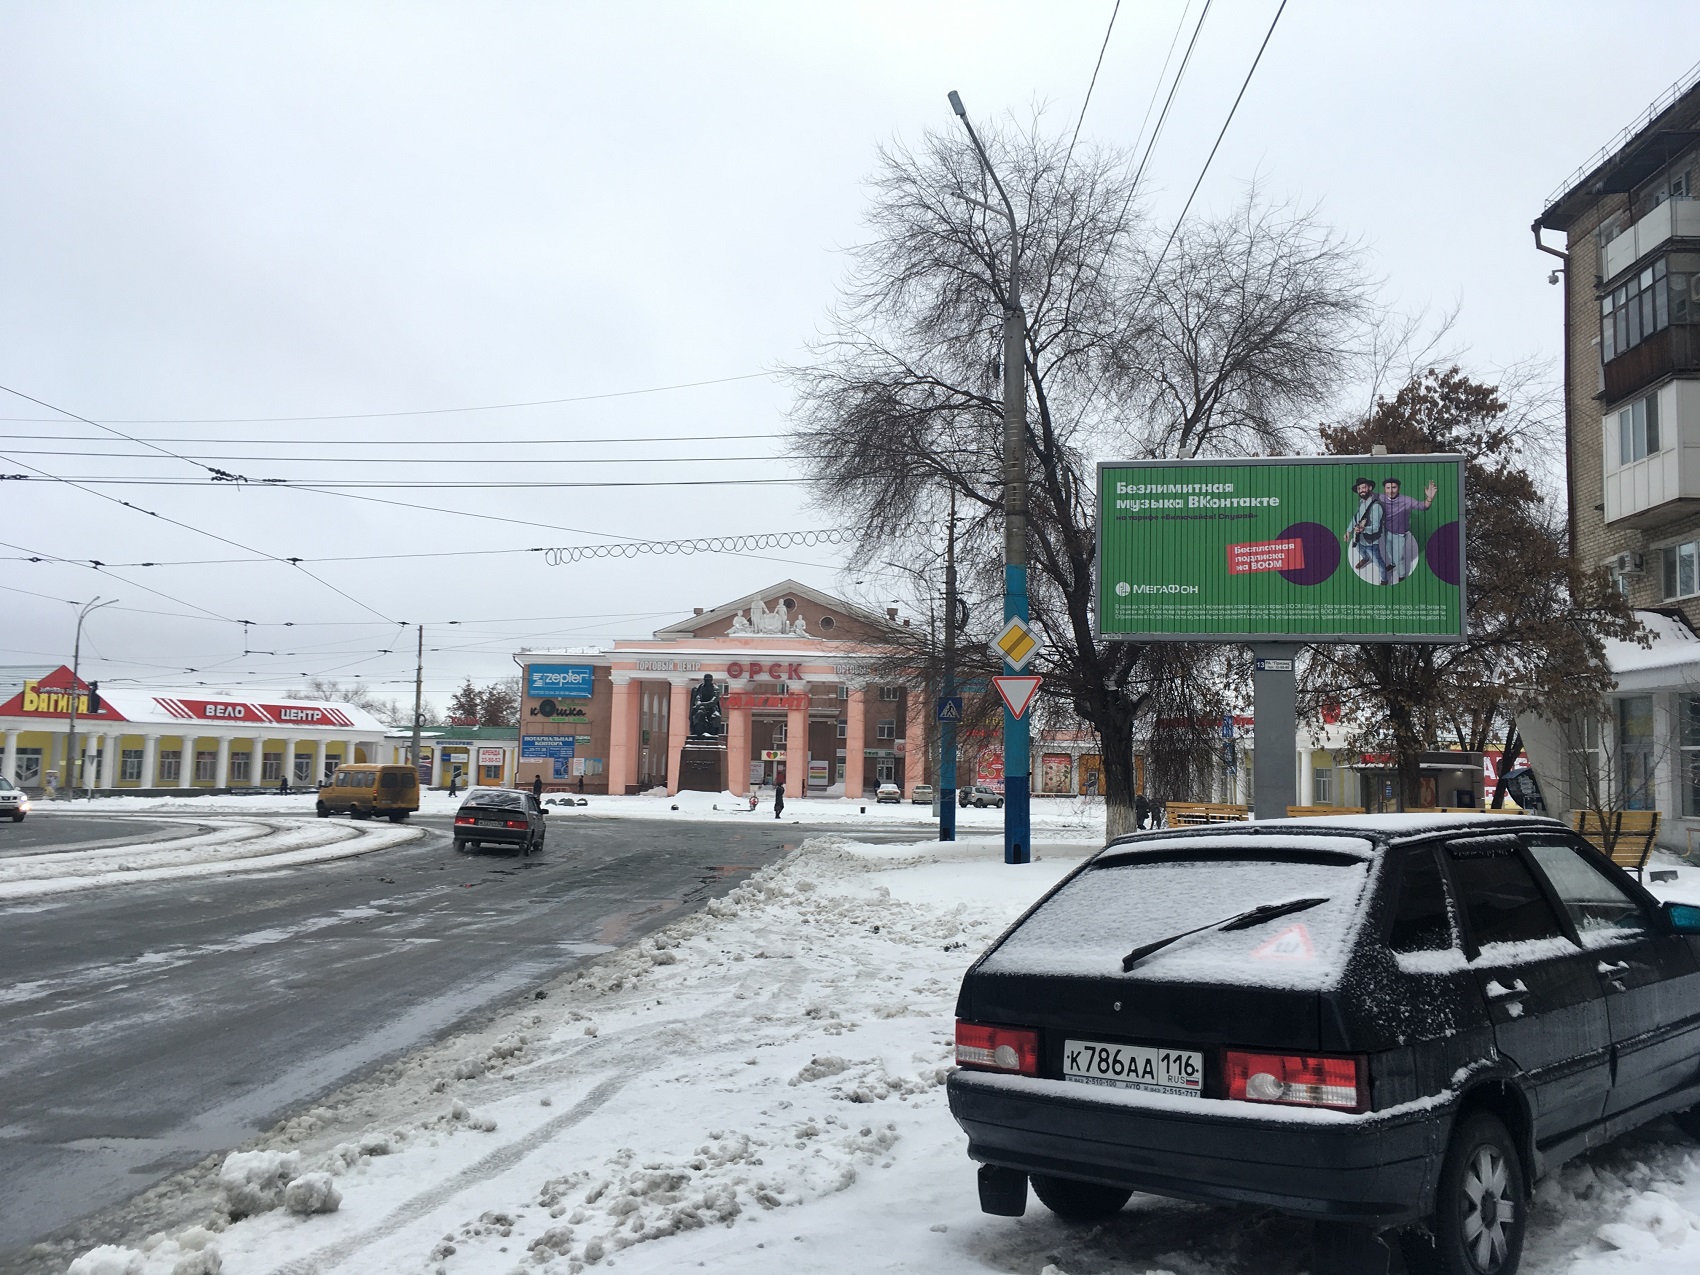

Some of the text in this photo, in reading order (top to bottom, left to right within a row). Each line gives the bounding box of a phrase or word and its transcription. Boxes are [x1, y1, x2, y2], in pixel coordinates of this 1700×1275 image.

[1116, 481, 1234, 494] Безлимитная
[1116, 495, 1280, 512] музыка ВКонтакте
[1234, 543, 1295, 554] Бесплатная
[1236, 552, 1285, 563] подписка
[637, 661, 700, 671] ТОРГОВЫЙ ЦЕНТР
[727, 662, 804, 680] ОРСК
[543, 669, 589, 687] zepter
[726, 696, 805, 708] МАГНИТ
[205, 704, 322, 721] ВЕЛО ЦЕНТР
[1161, 1052, 1196, 1077] 116
[1167, 1074, 1186, 1085] RUS
